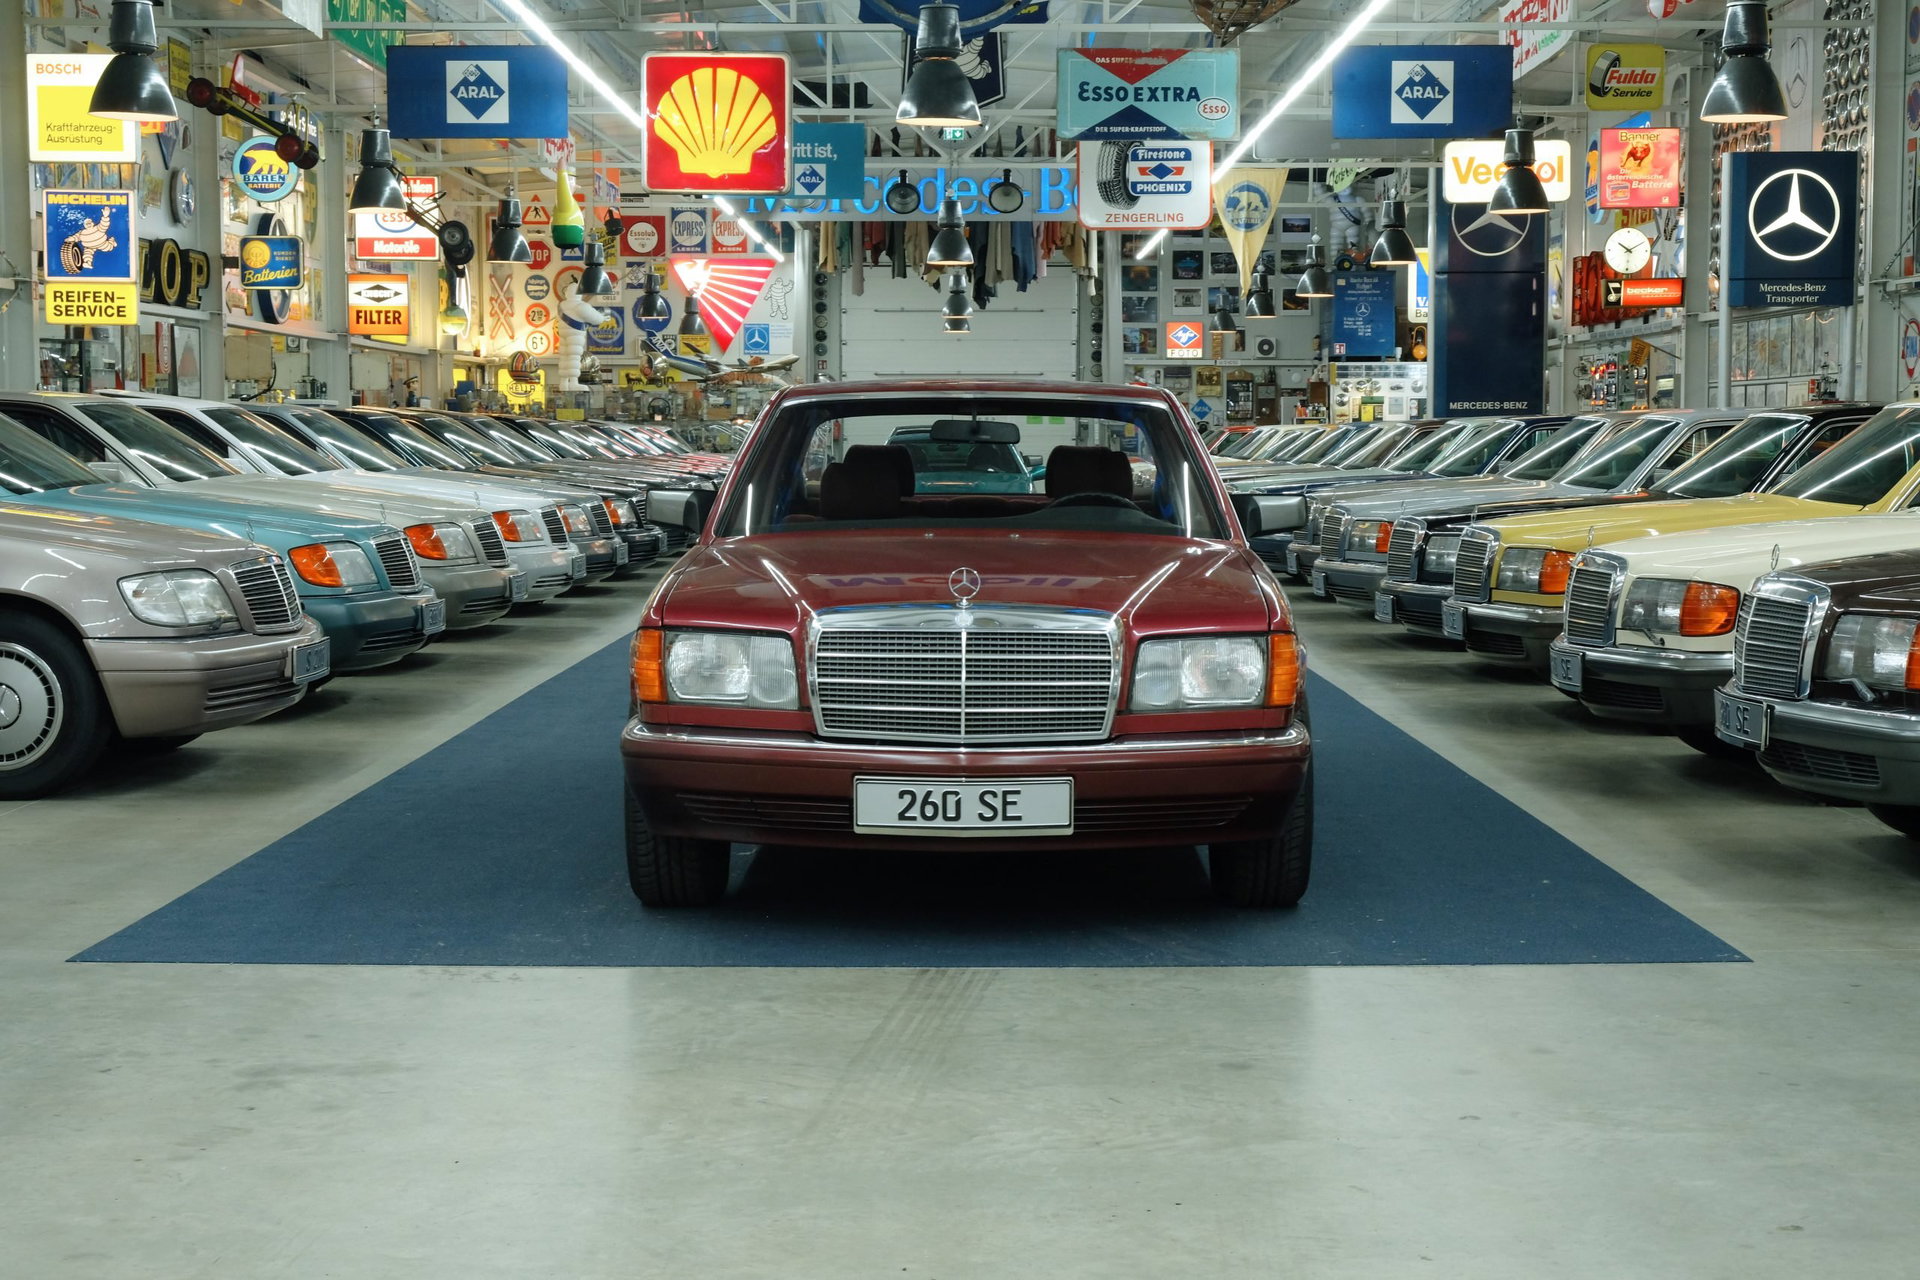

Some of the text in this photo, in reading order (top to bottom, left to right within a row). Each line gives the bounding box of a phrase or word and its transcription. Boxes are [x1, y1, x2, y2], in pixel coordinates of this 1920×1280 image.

[36, 63, 82, 75] BOSCH
[1606, 68, 1657, 85] Fulda
[457, 85, 499, 99] ARAL
[1133, 86, 1201, 102] EXTRA
[1401, 86, 1444, 99] ARAL
[1612, 88, 1653, 99] Service
[46, 122, 117, 135] Kraftfahrzeug-
[46, 133, 103, 146] Ausrüstung
[1620, 131, 1660, 142] Banner
[1136, 149, 1186, 160] Firestone
[1451, 155, 1564, 186] Veeol
[800, 175, 822, 184] ARAL
[1632, 180, 1673, 189] Batterie
[1136, 183, 1186, 193] PHOENIX
[47, 194, 128, 206] MICHELIN
[1105, 213, 1184, 223] ZENGERLING
[674, 220, 704, 237] EXPRESS
[530, 249, 549, 261] TOP
[1759, 282, 1827, 292] Mercedes-Benz
[53, 290, 126, 303] REIFEN-
[1766, 294, 1820, 304] Transporter
[53, 304, 127, 318] SERVICE
[355, 309, 402, 325] FILTER
[531, 336, 538, 350] 6
[1170, 349, 1199, 357] FOTO
[1449, 401, 1529, 410] MERCEDES-BENZ
[1560, 657, 1573, 681] SE
[1735, 704, 1751, 735] SE
[897, 788, 1023, 822] 260 SE
